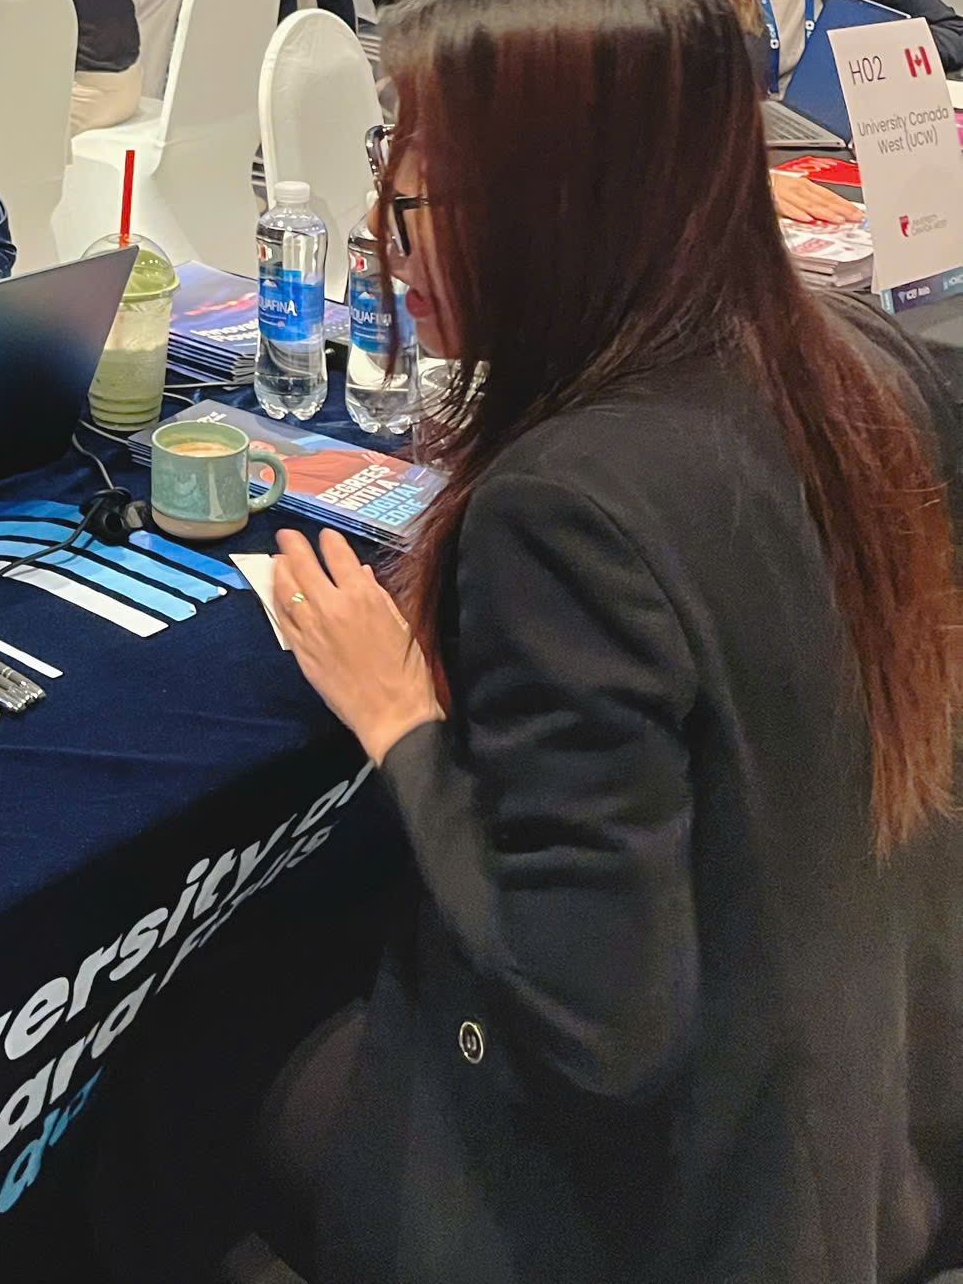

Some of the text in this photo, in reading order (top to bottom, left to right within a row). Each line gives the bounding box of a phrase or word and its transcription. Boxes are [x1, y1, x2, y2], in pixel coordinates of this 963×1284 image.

[849, 55, 886, 86] H02
[857, 107, 949, 137] University Canada
[878, 124, 939, 154] West (UCW)
[315, 464, 391, 504] DEGREES
[335, 479, 400, 511] WITH A
[356, 483, 425, 519] DIGITAL
[378, 498, 423, 526] EDGE
